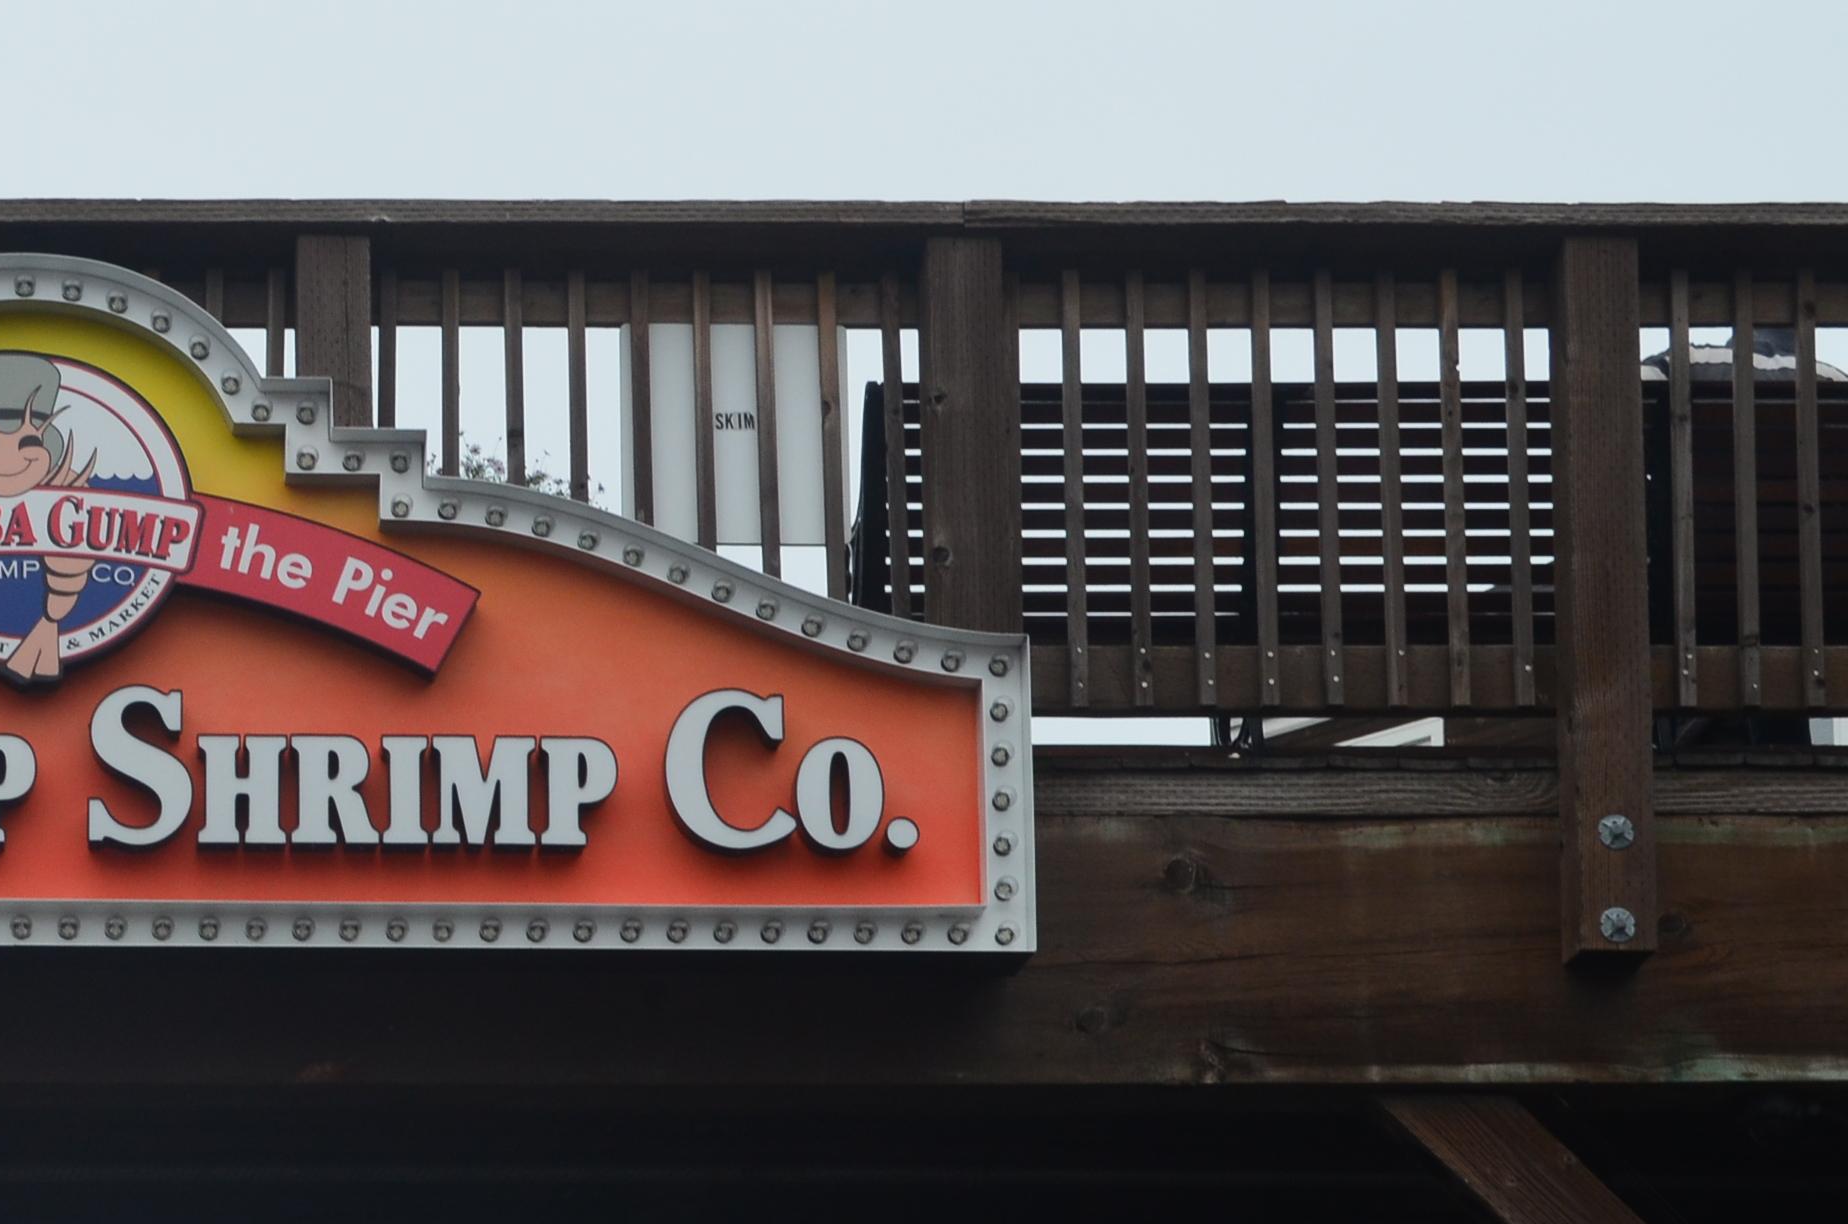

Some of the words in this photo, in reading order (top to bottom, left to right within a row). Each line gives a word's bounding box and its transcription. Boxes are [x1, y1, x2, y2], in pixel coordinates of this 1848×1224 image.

[47, 495, 191, 560] GUMP
[66, 636, 82, 650] &
[88, 573, 163, 643] MARKET
[91, 565, 136, 587] CO.
[221, 524, 315, 590] the
[332, 555, 449, 642] Pier
[88, 685, 620, 850] SHRIMP
